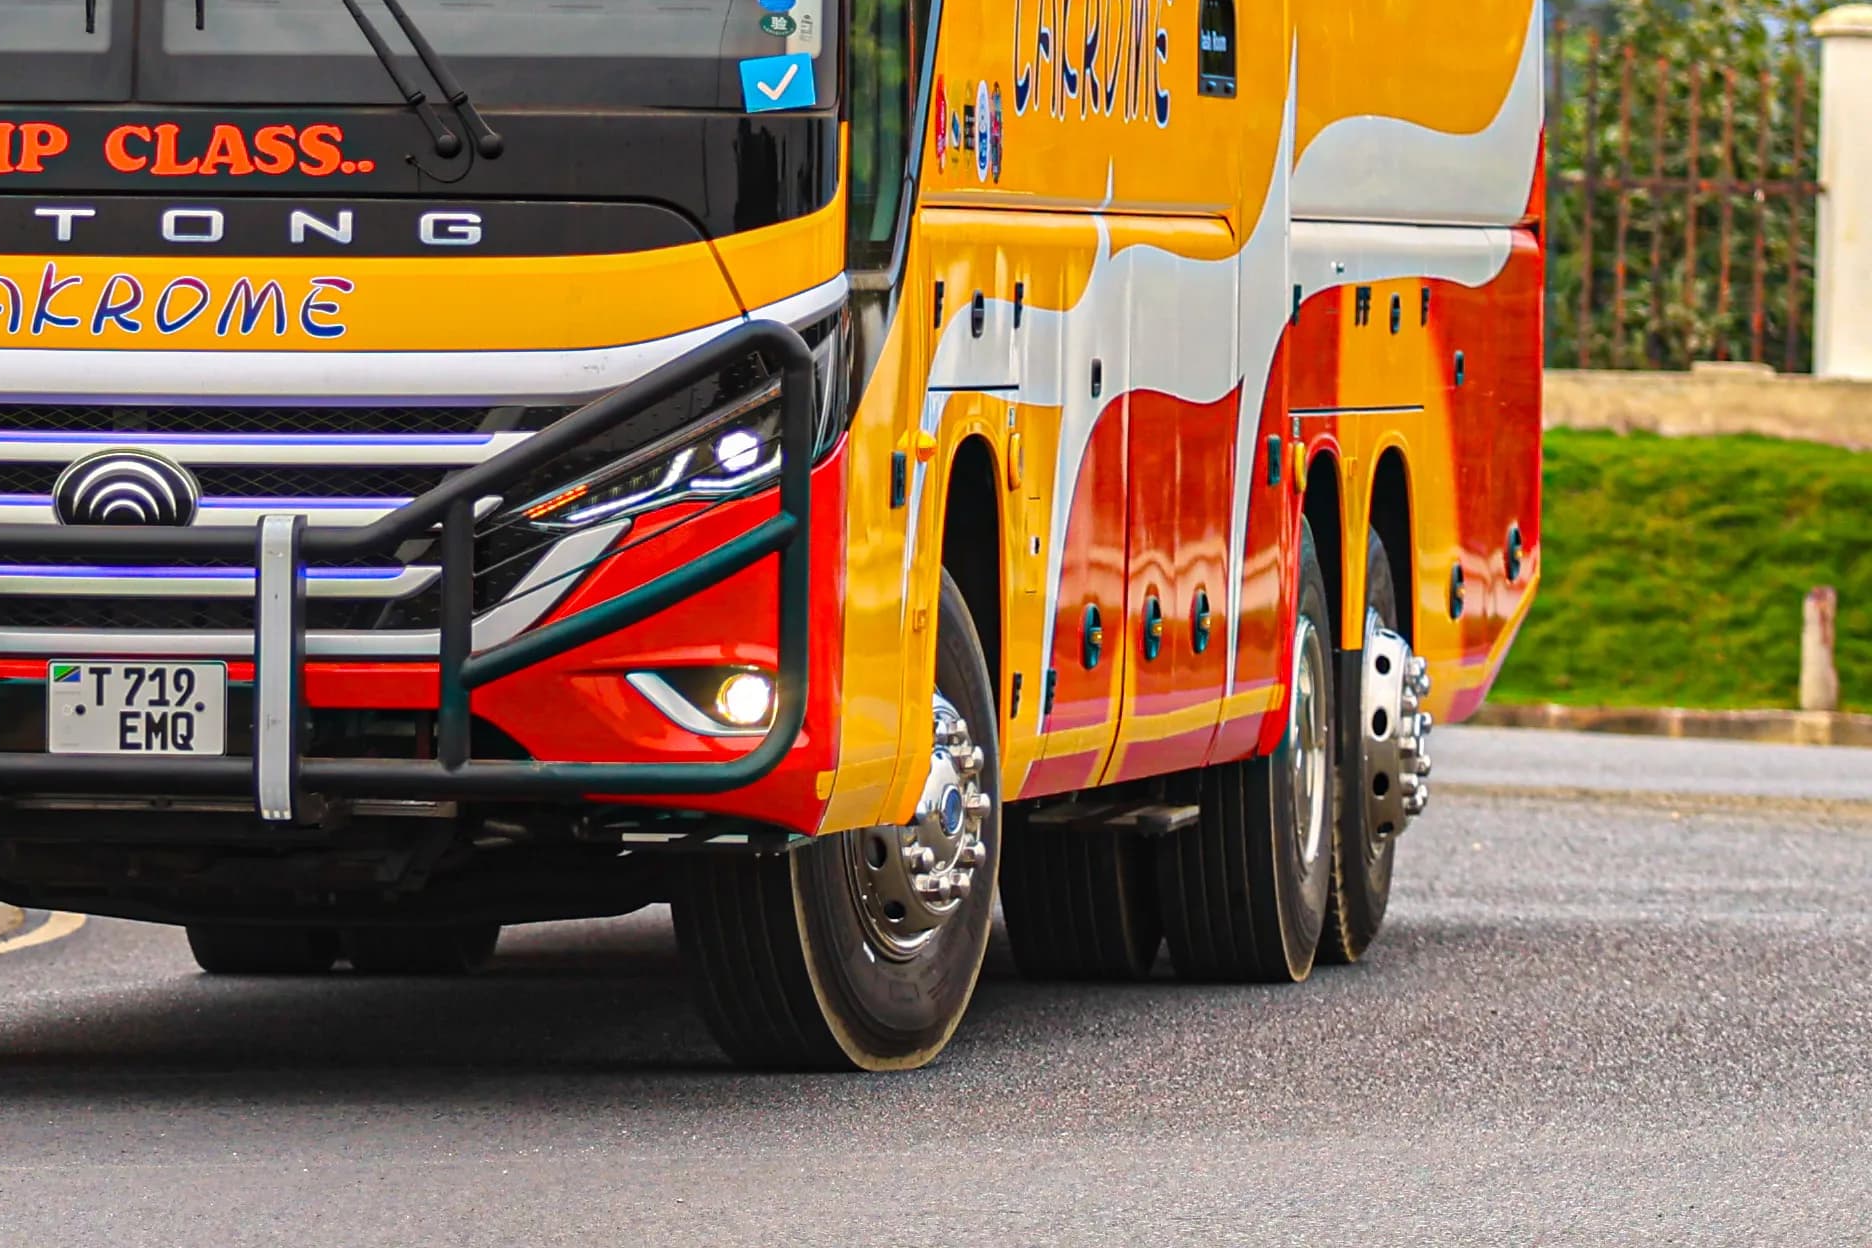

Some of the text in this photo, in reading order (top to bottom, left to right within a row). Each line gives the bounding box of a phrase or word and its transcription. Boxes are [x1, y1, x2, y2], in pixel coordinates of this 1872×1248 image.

[103, 122, 375, 176] CLASS..
[89, 667, 195, 707] T 719
[119, 711, 194, 751] EMQ
